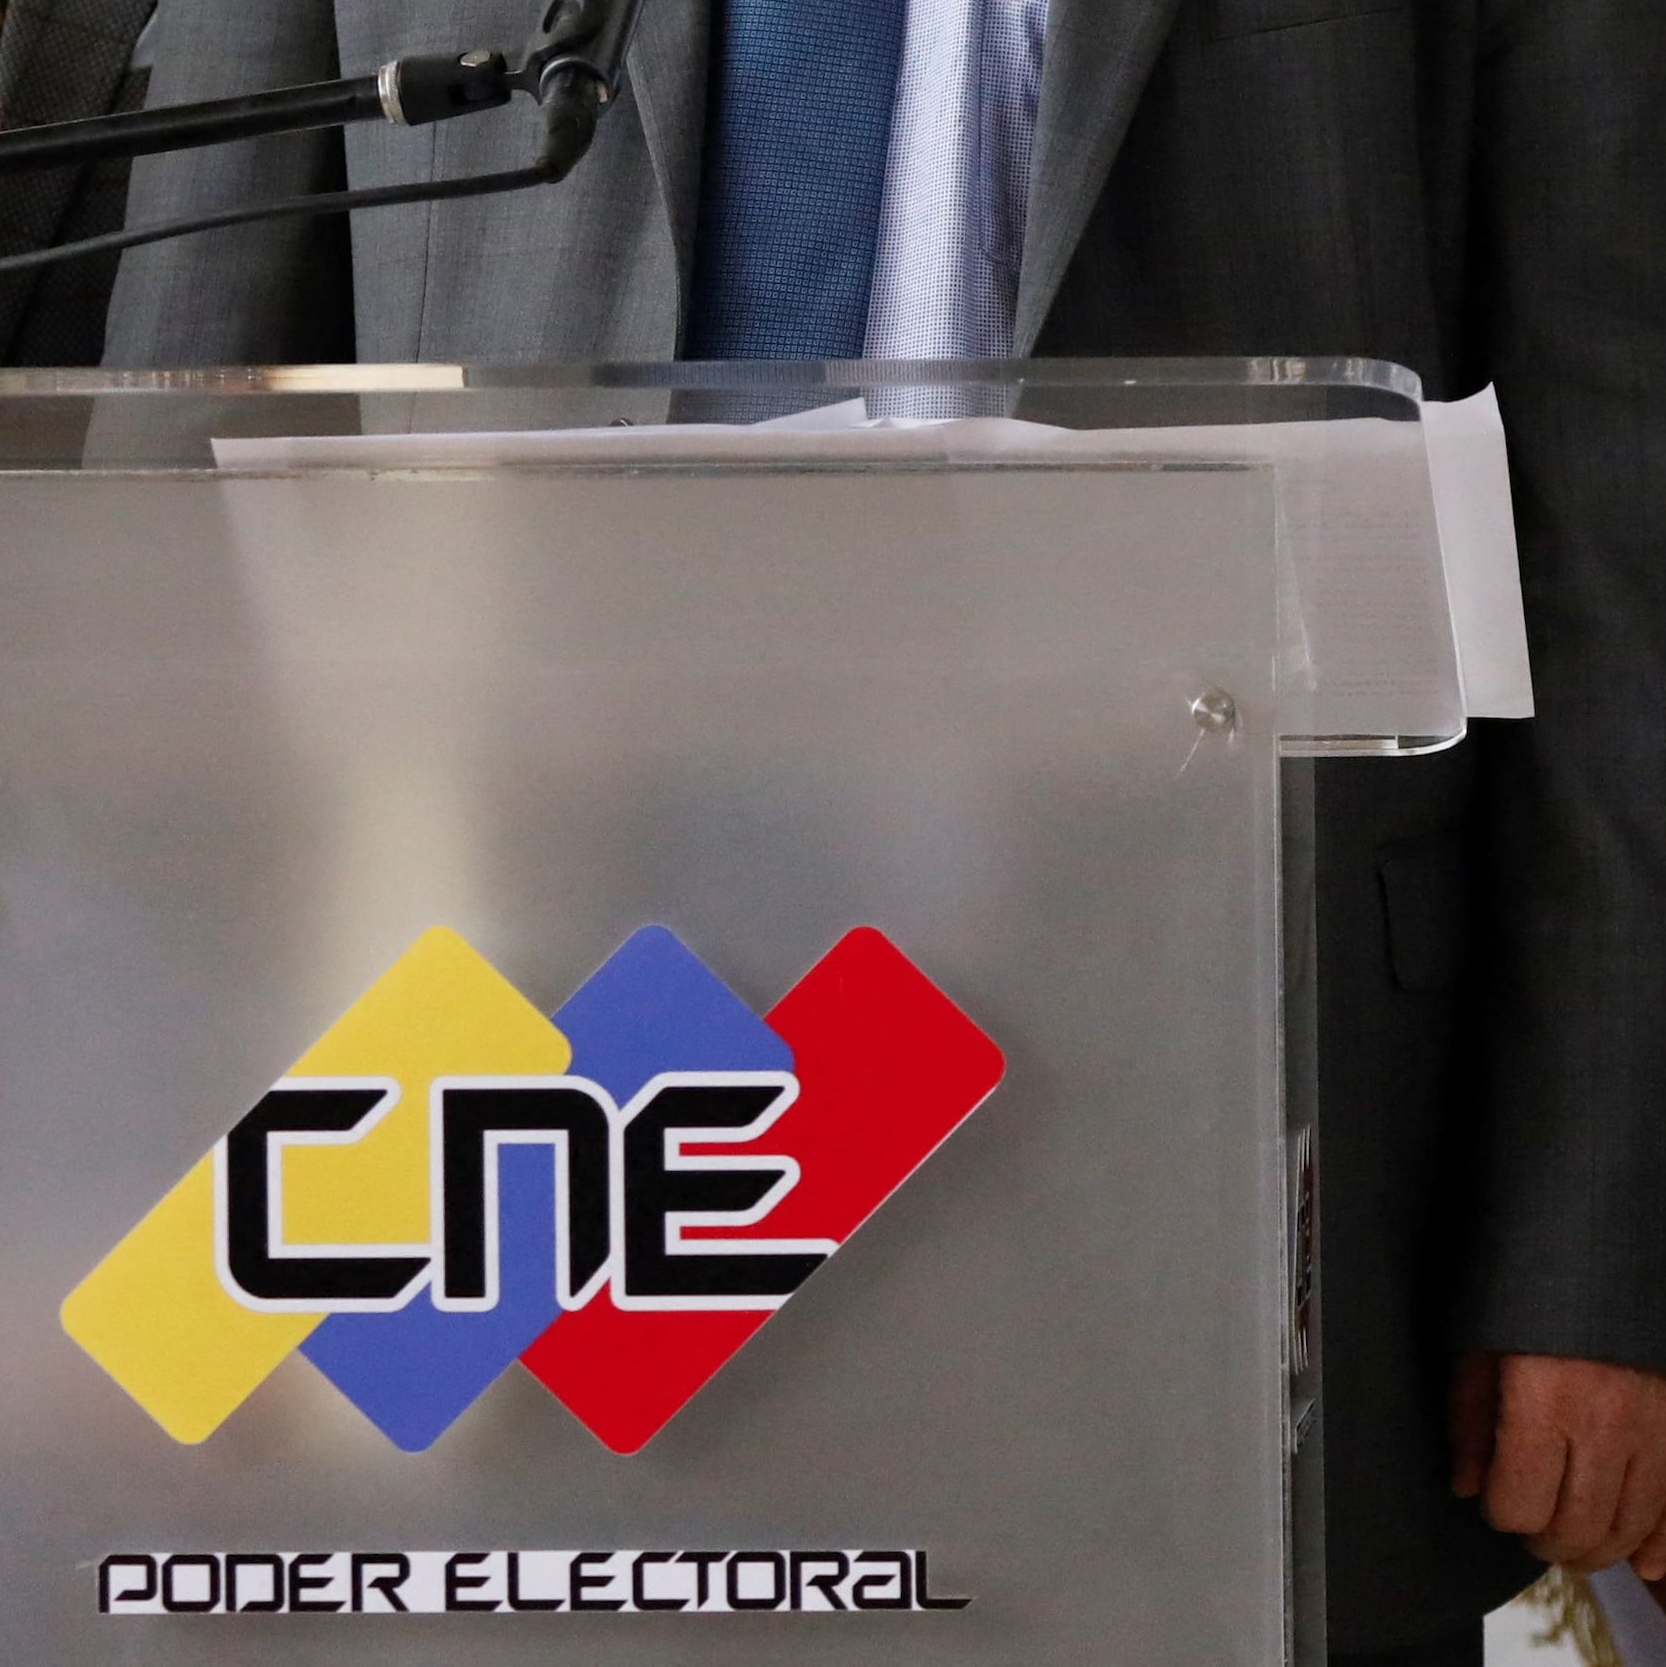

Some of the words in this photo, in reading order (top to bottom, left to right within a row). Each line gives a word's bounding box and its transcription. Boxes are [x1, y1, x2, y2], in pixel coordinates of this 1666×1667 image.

[222, 1080, 835, 1304] CNE
[98, 1553, 410, 1613] PODER
[444, 1550, 973, 1612] ELECTORAL
